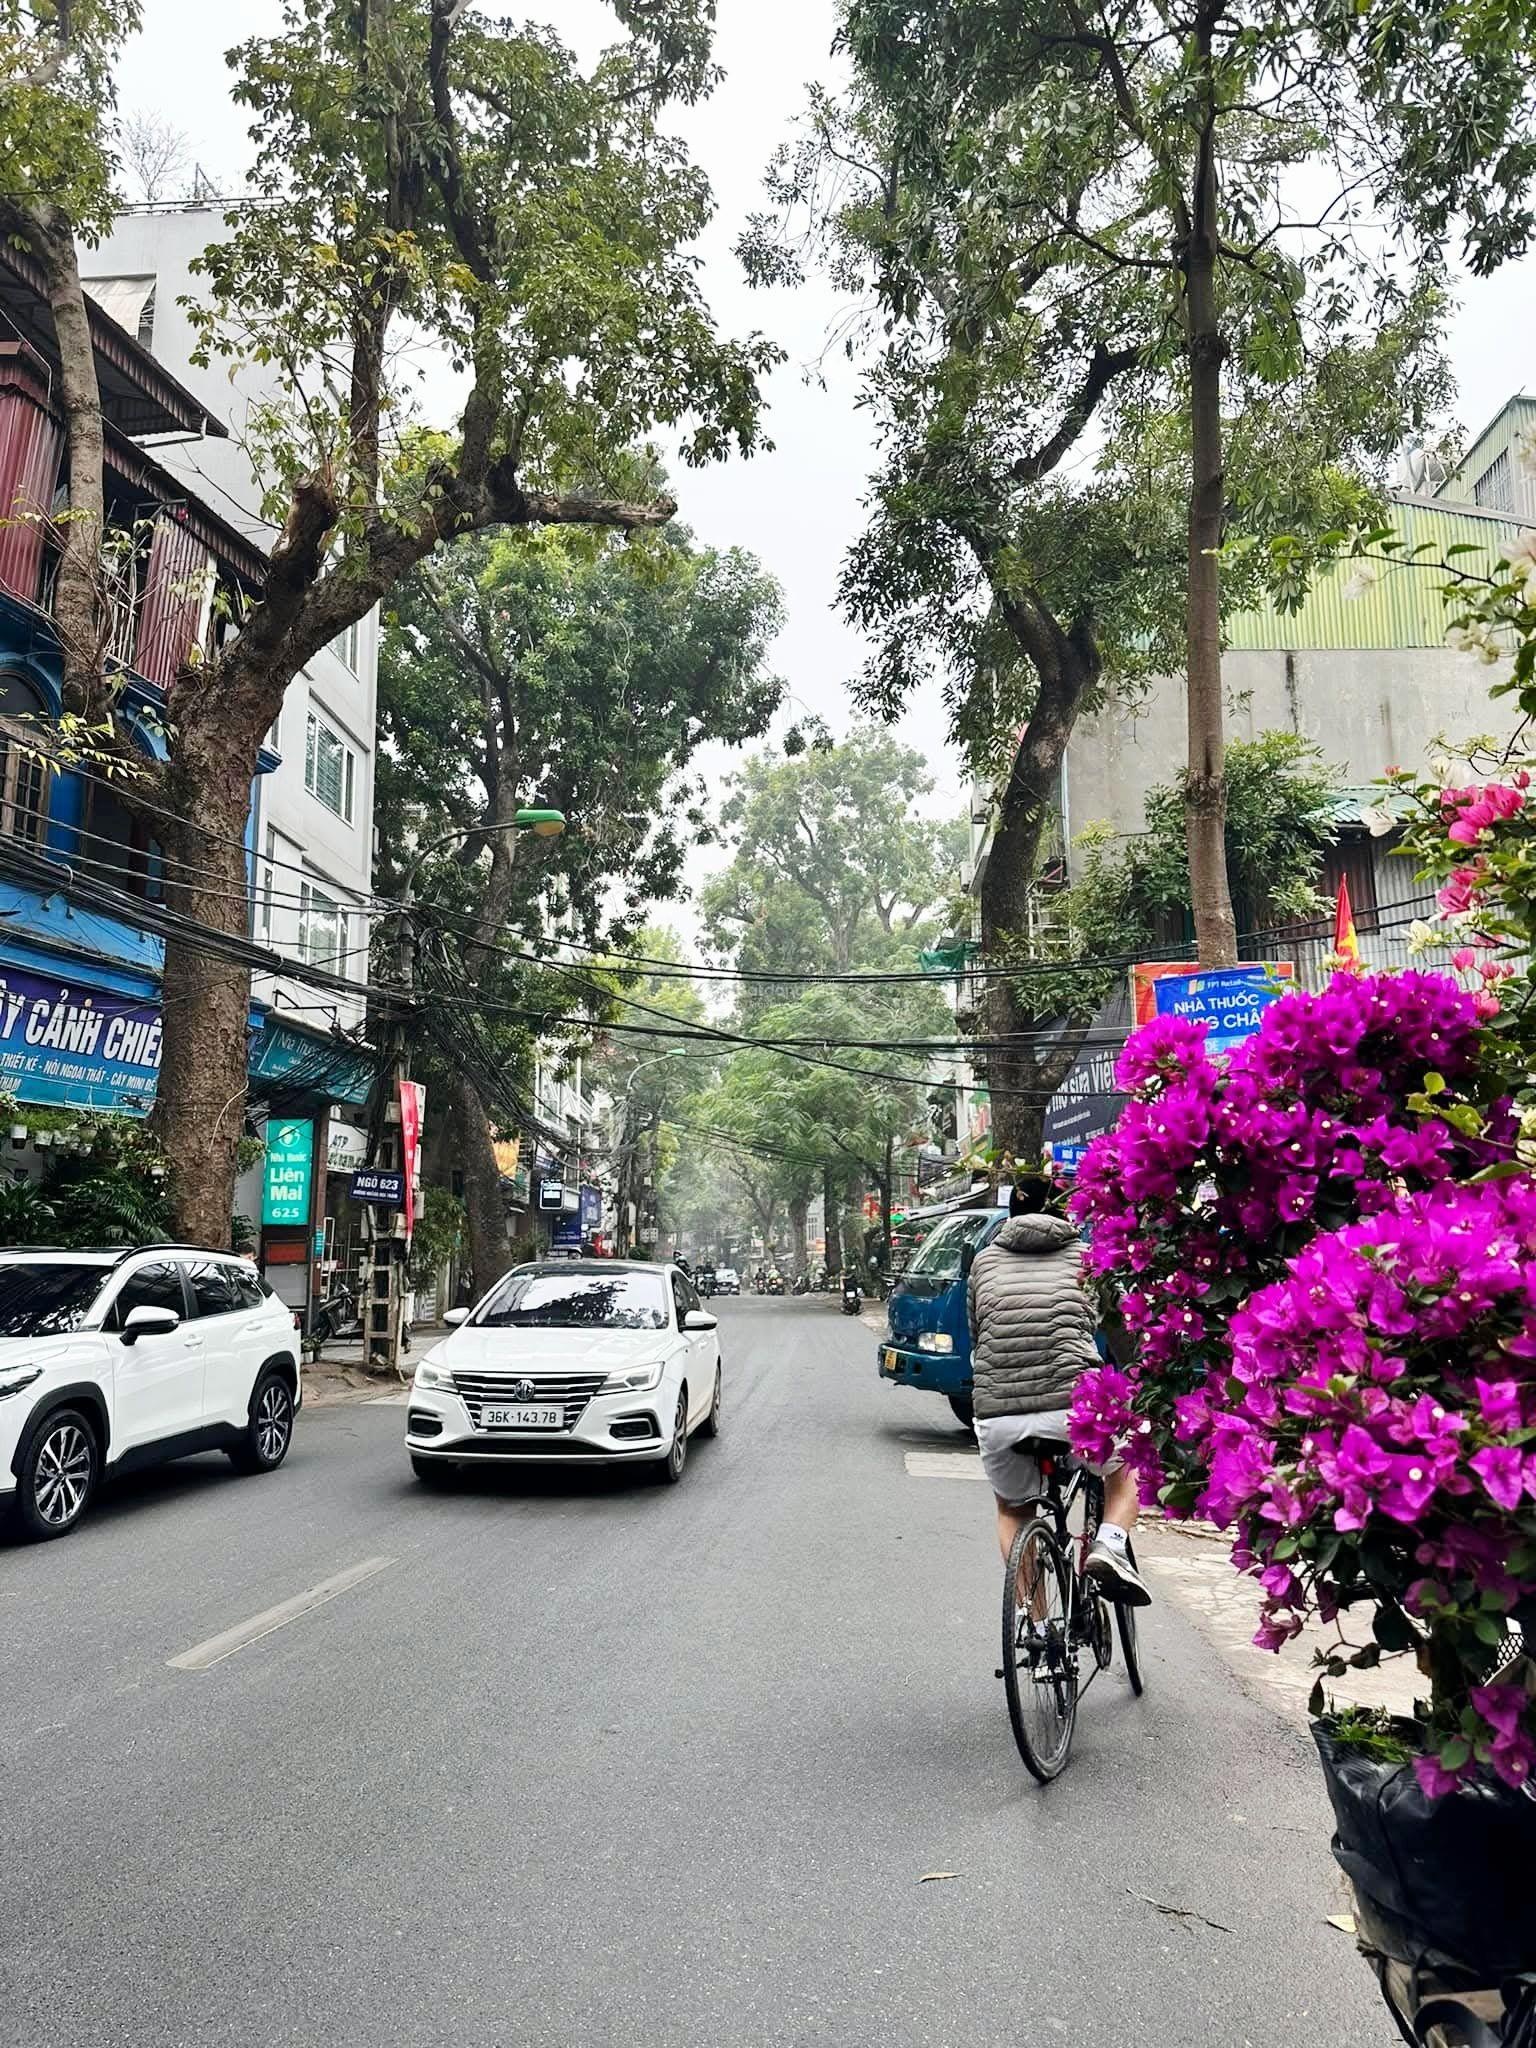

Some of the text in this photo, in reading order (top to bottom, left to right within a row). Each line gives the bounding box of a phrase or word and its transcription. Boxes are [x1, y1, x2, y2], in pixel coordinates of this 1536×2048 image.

[1174, 990, 1260, 1014] NHÀ THUỐC
[0, 980, 26, 1039] Y
[25, 989, 105, 1056] CẢNH
[24, 1054, 42, 1071] KẾ
[60, 1063, 87, 1083] NGOẠI
[126, 1075, 146, 1089] MINI
[270, 1167, 305, 1183] Liên
[356, 1175, 399, 1190] NGÕ 623
[270, 1184, 303, 1201] Mai
[271, 1207, 300, 1218] 625
